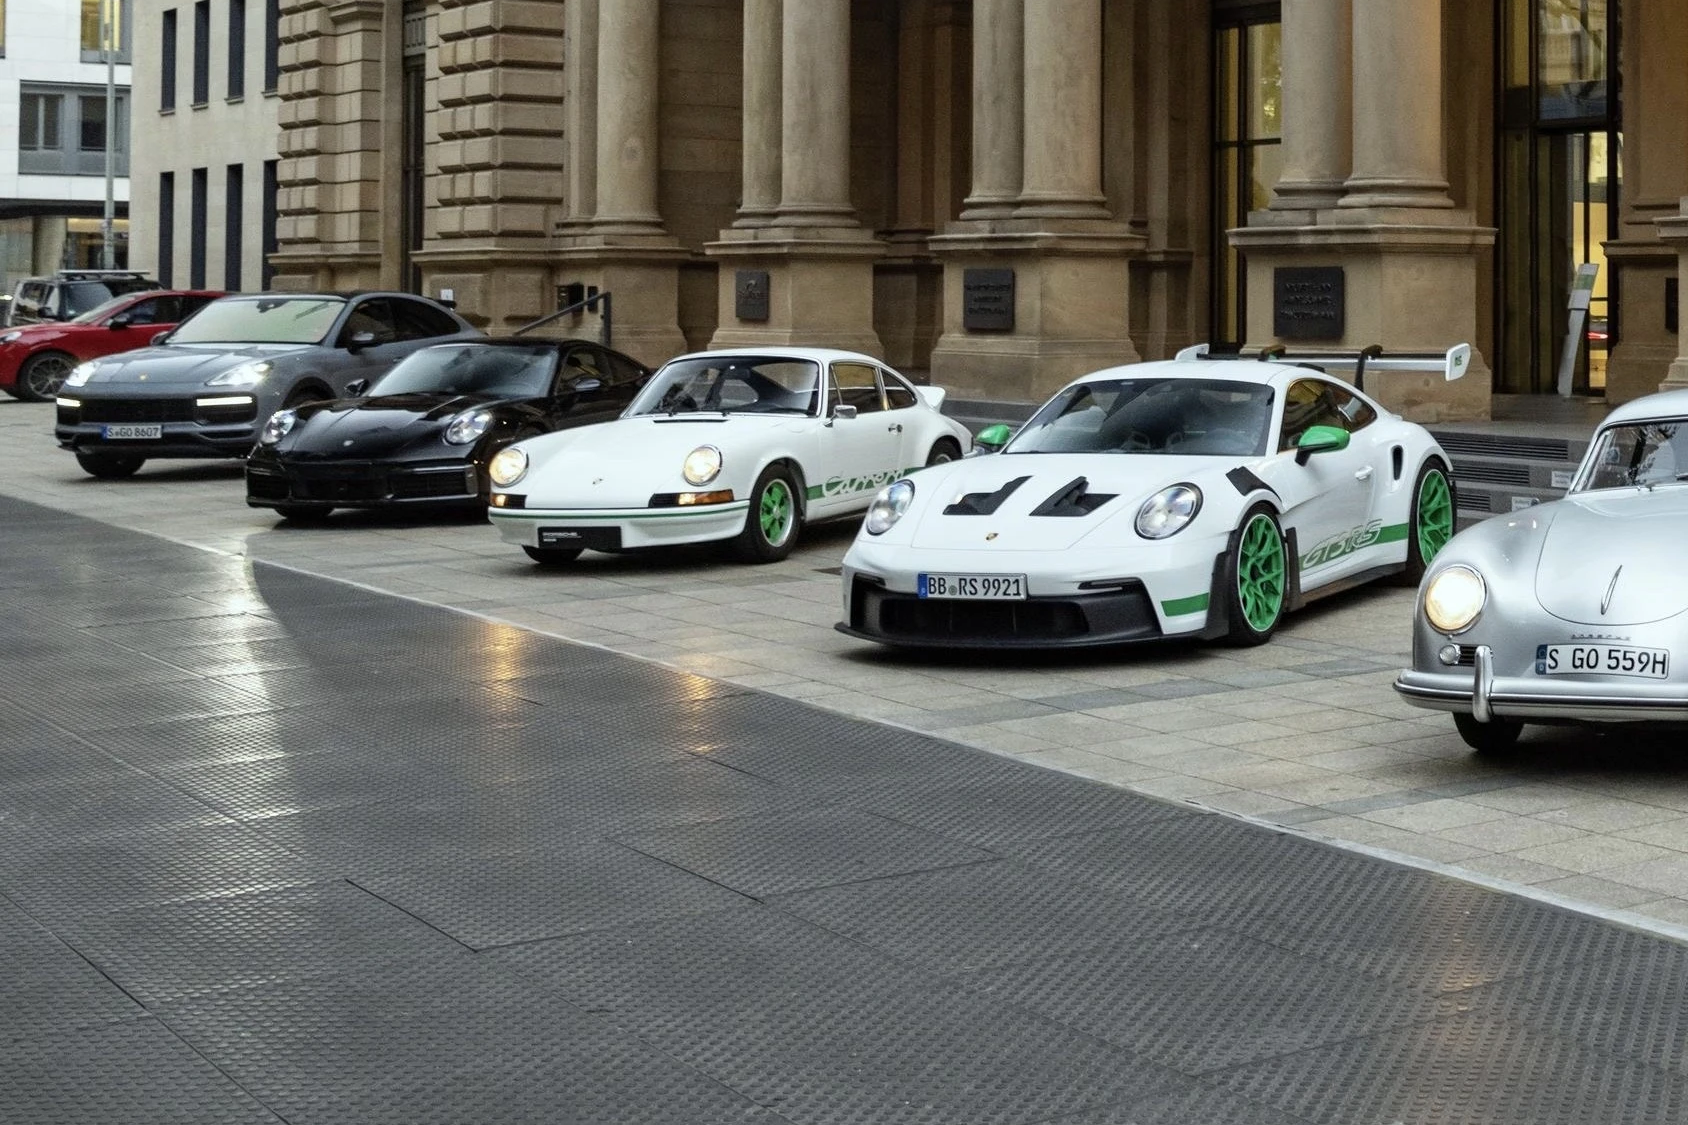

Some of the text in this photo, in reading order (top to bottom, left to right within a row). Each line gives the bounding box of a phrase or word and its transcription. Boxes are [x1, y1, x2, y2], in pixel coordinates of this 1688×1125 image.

[108, 427, 114, 437] S
[928, 577, 947, 595] BB
[958, 578, 978, 596] RS
[982, 578, 1021, 596] 9921
[1547, 648, 1559, 670] S
[1571, 648, 1599, 670] GO
[1606, 649, 1667, 675] 559H
